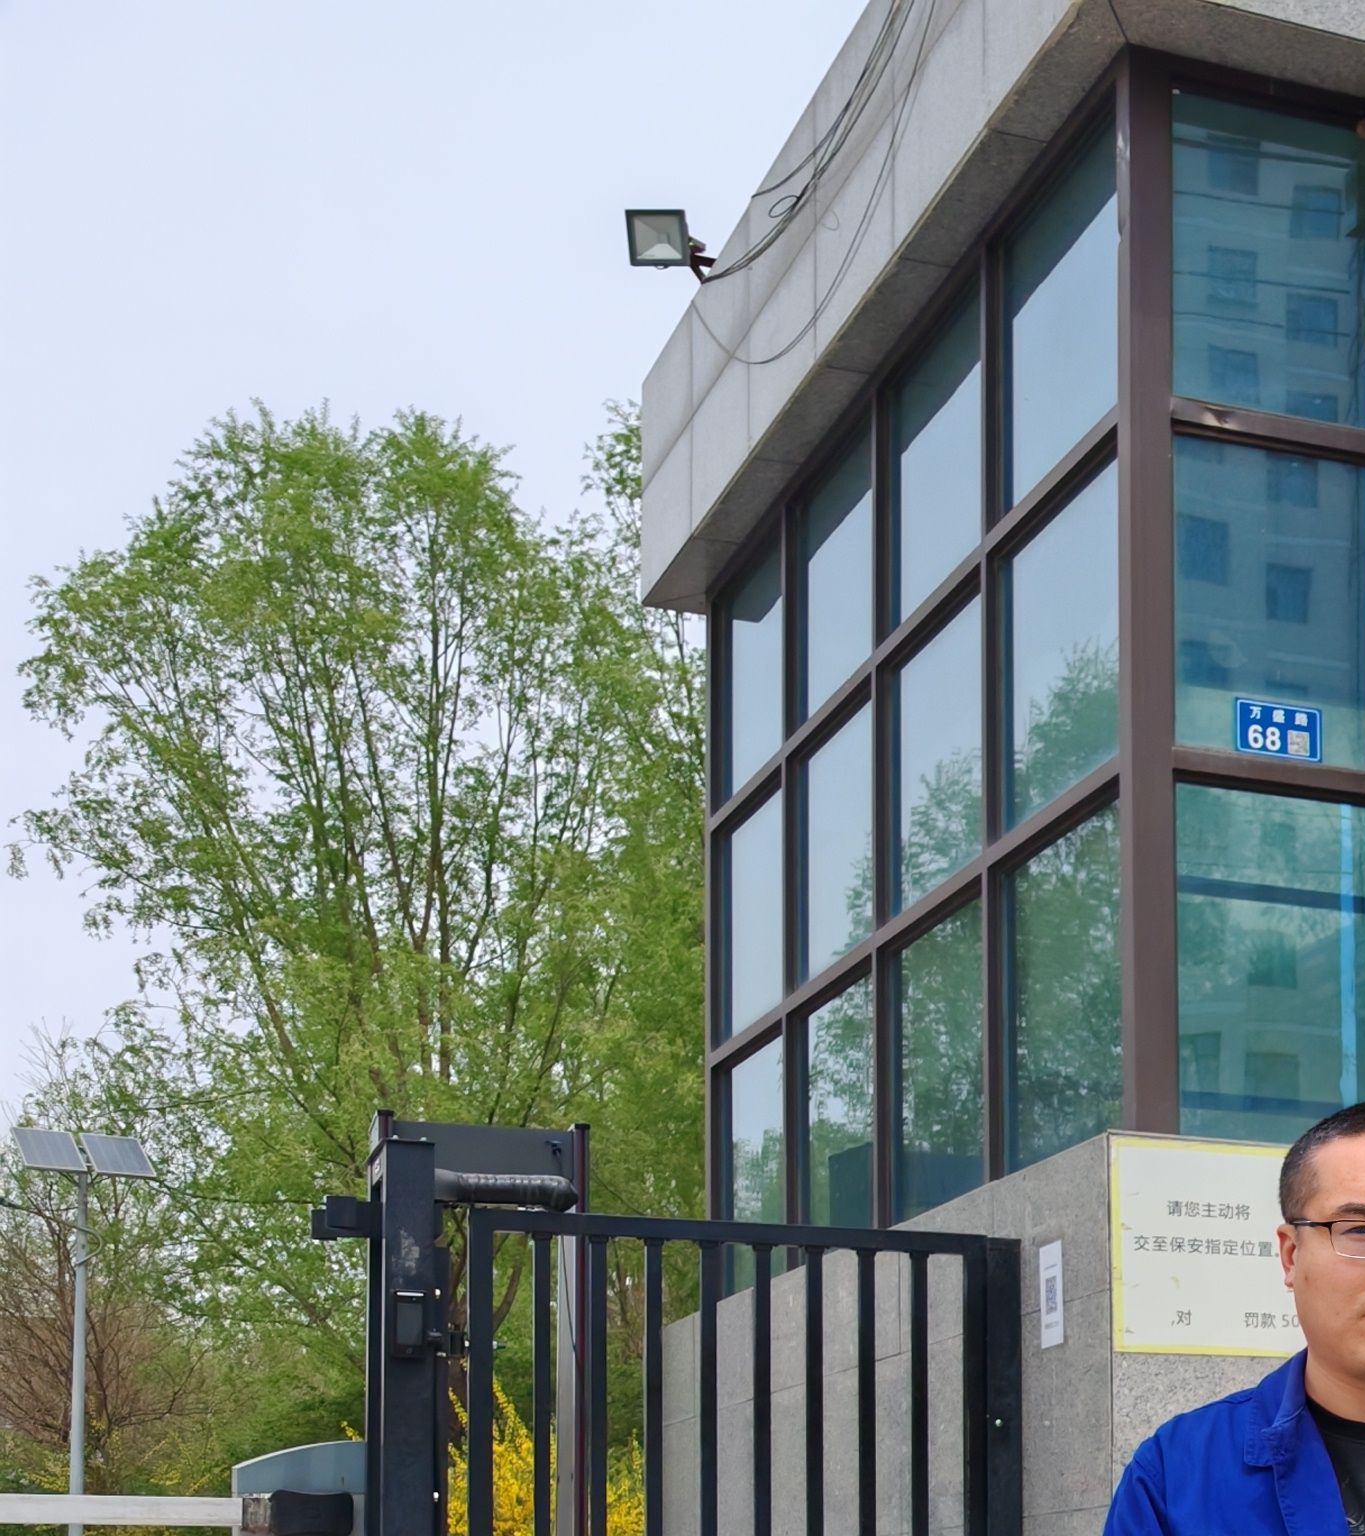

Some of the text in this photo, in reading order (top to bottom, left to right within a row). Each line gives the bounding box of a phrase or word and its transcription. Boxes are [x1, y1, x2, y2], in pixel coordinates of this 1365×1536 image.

[1248, 724, 1281, 751] 68
[1167, 1201, 1251, 1221] 请您主动将
